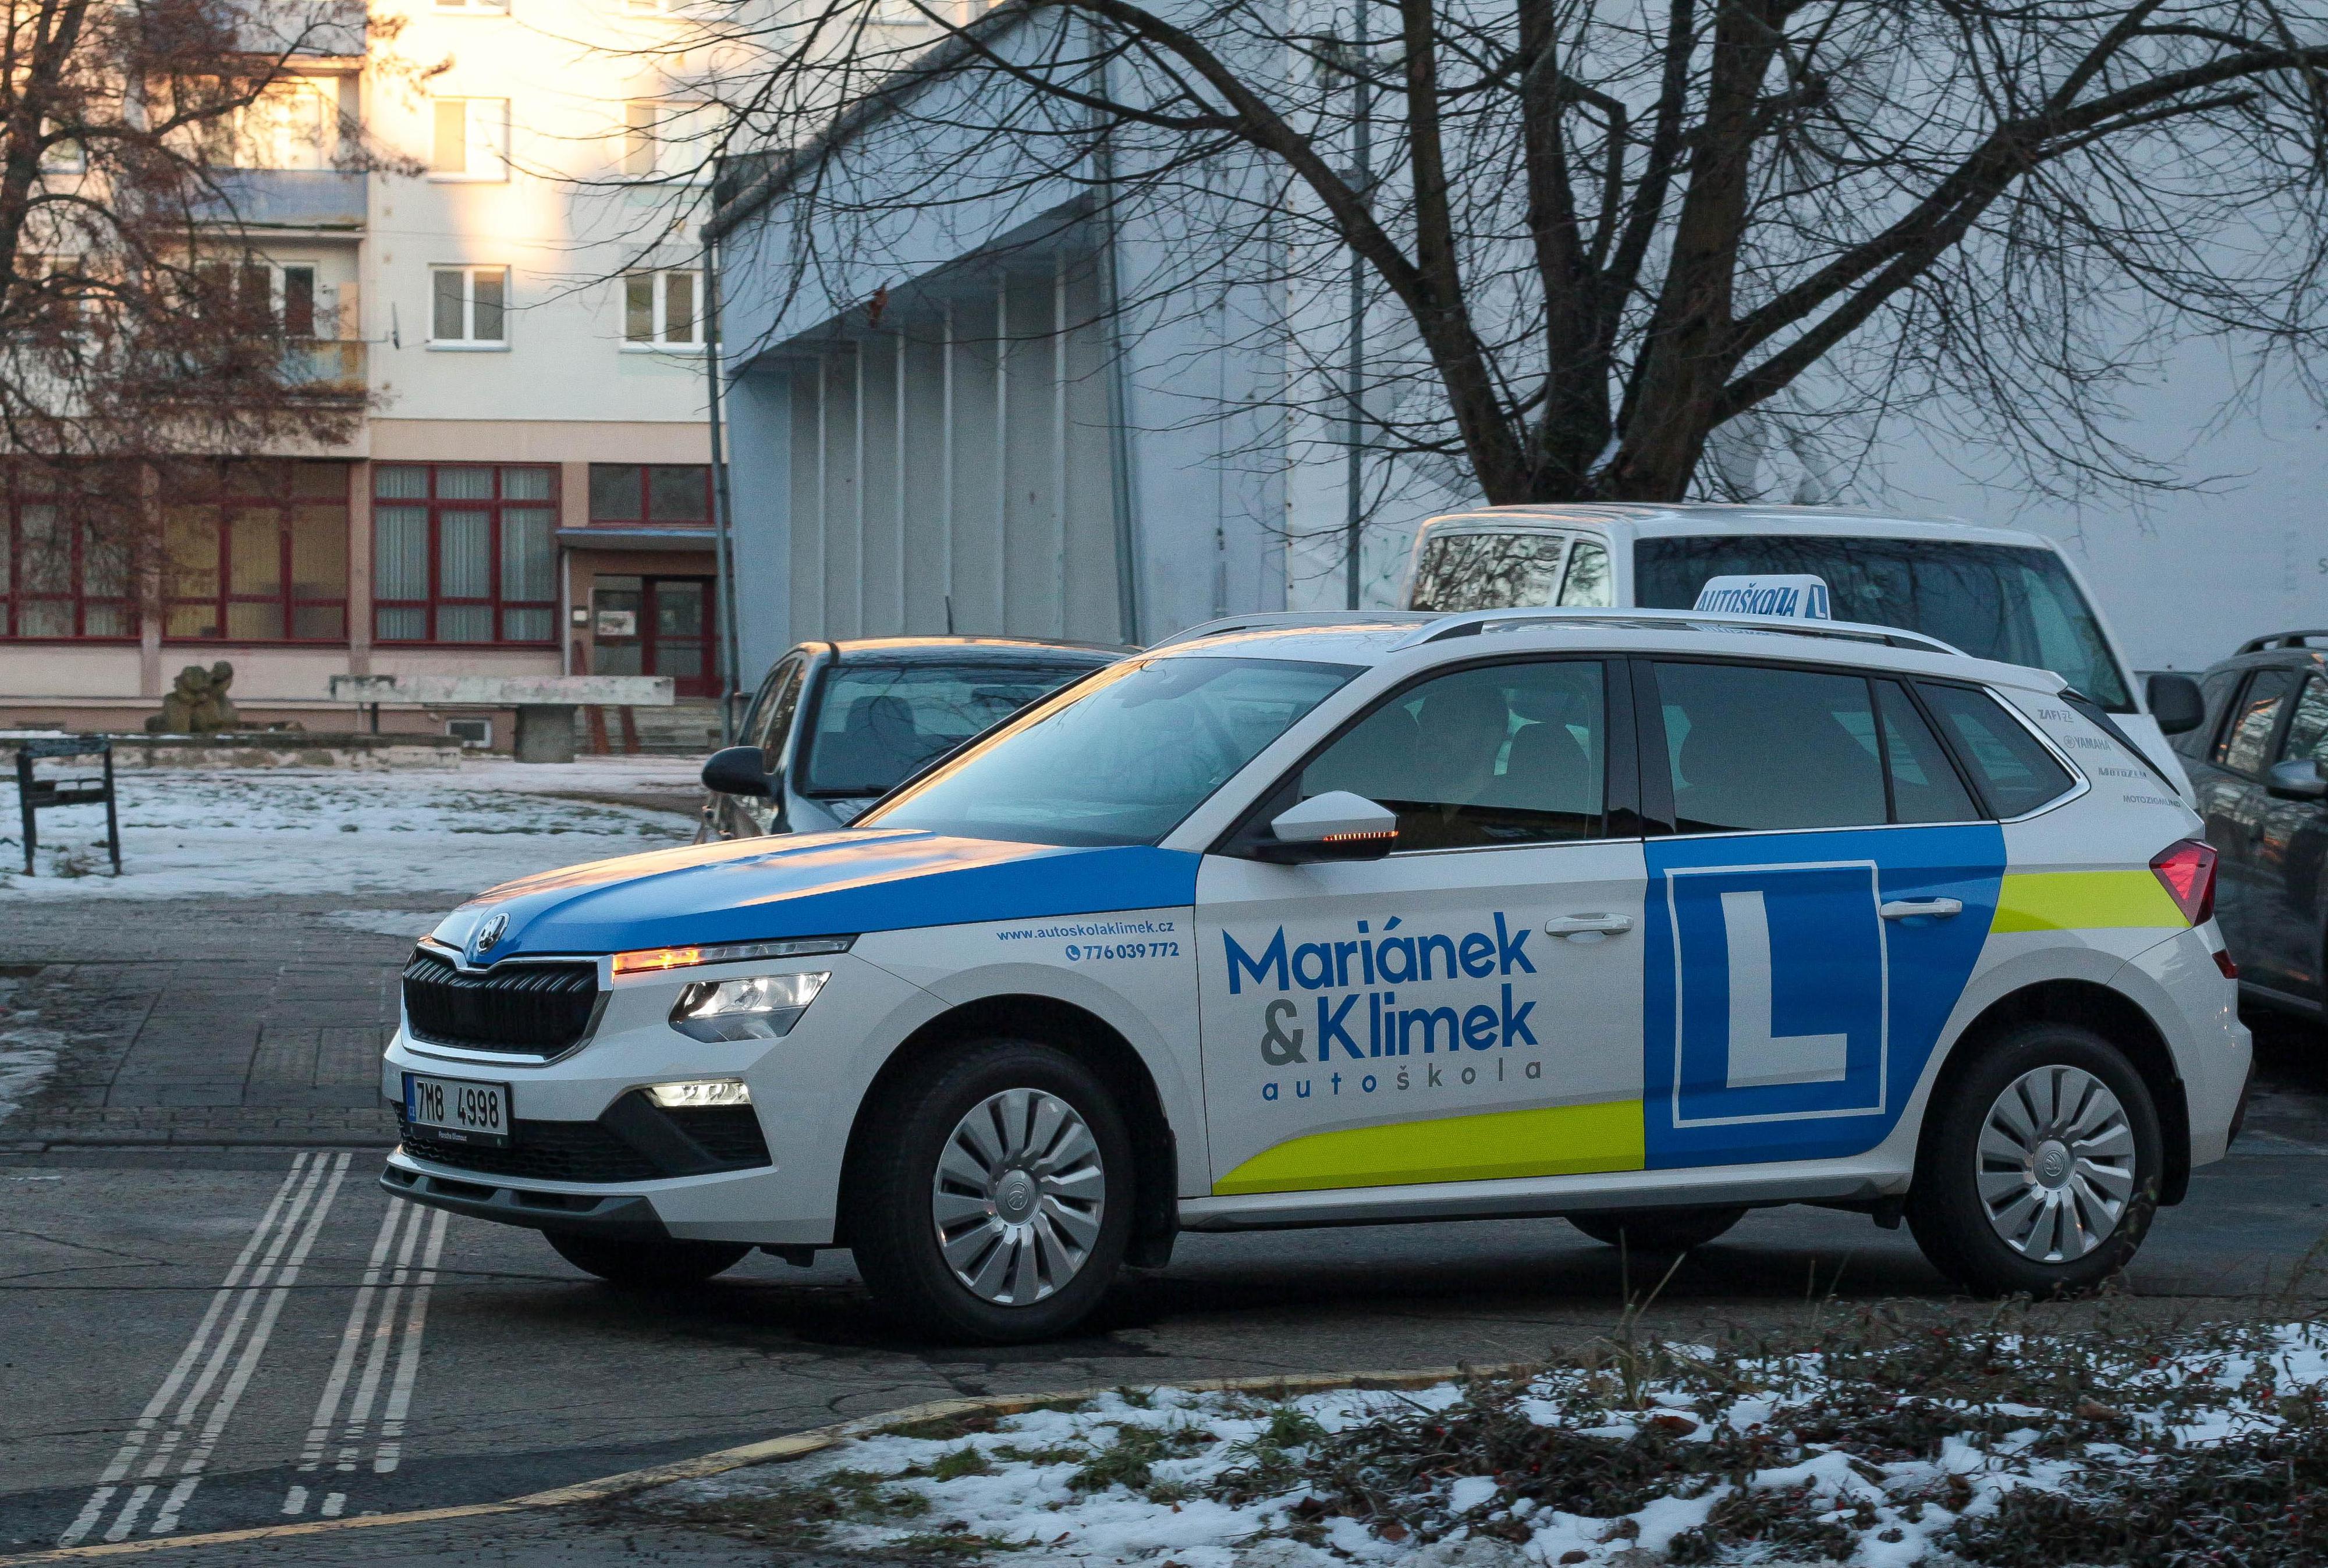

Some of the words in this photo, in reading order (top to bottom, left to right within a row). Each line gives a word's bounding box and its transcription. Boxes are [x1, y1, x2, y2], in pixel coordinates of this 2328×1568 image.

[1695, 582, 1799, 617] AUTOŠKOLA
[2074, 737, 2111, 751] YAMAHA
[996, 920, 1175, 941] www.autoskolaklimek.cz
[1083, 945, 1115, 960] 776
[1116, 944, 1146, 959] 039
[1148, 941, 1179, 957] 772
[1222, 911, 1537, 995] Mariánek
[1720, 891, 1847, 1088] L
[1316, 983, 1539, 1062] Klimek
[1262, 1057, 1542, 1101] autoškola
[416, 1081, 445, 1122] 7M8
[457, 1086, 500, 1128] 4998
